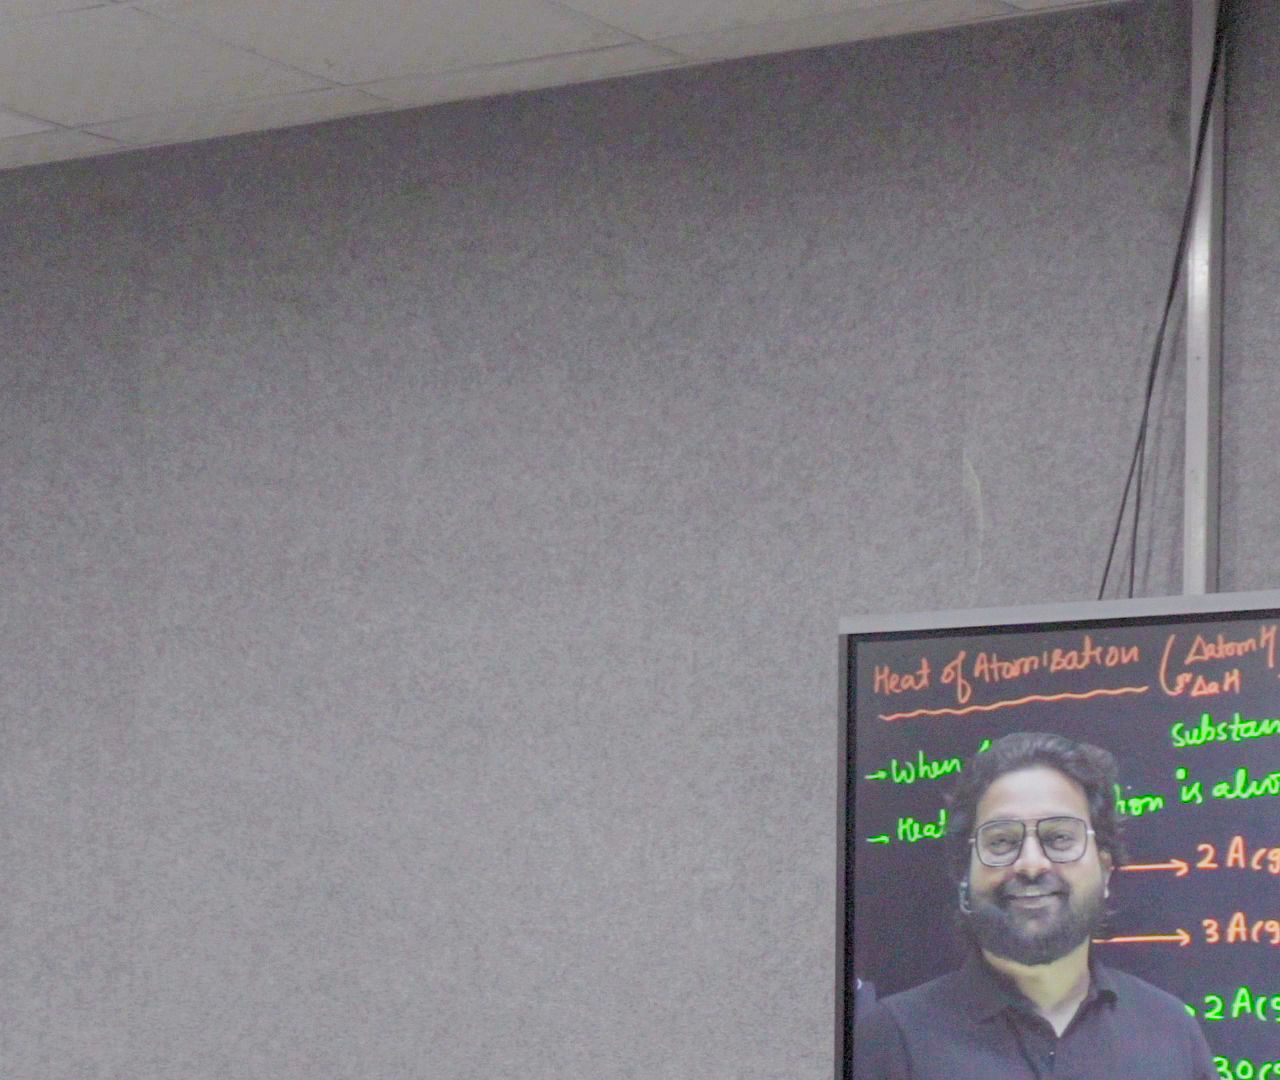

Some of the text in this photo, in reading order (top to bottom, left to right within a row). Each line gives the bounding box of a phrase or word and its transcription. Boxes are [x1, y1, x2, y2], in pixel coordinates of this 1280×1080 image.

[874, 661, 930, 695] Heat
[940, 651, 972, 704] of
[891, 749, 962, 784] When
[1176, 767, 1204, 805] is
